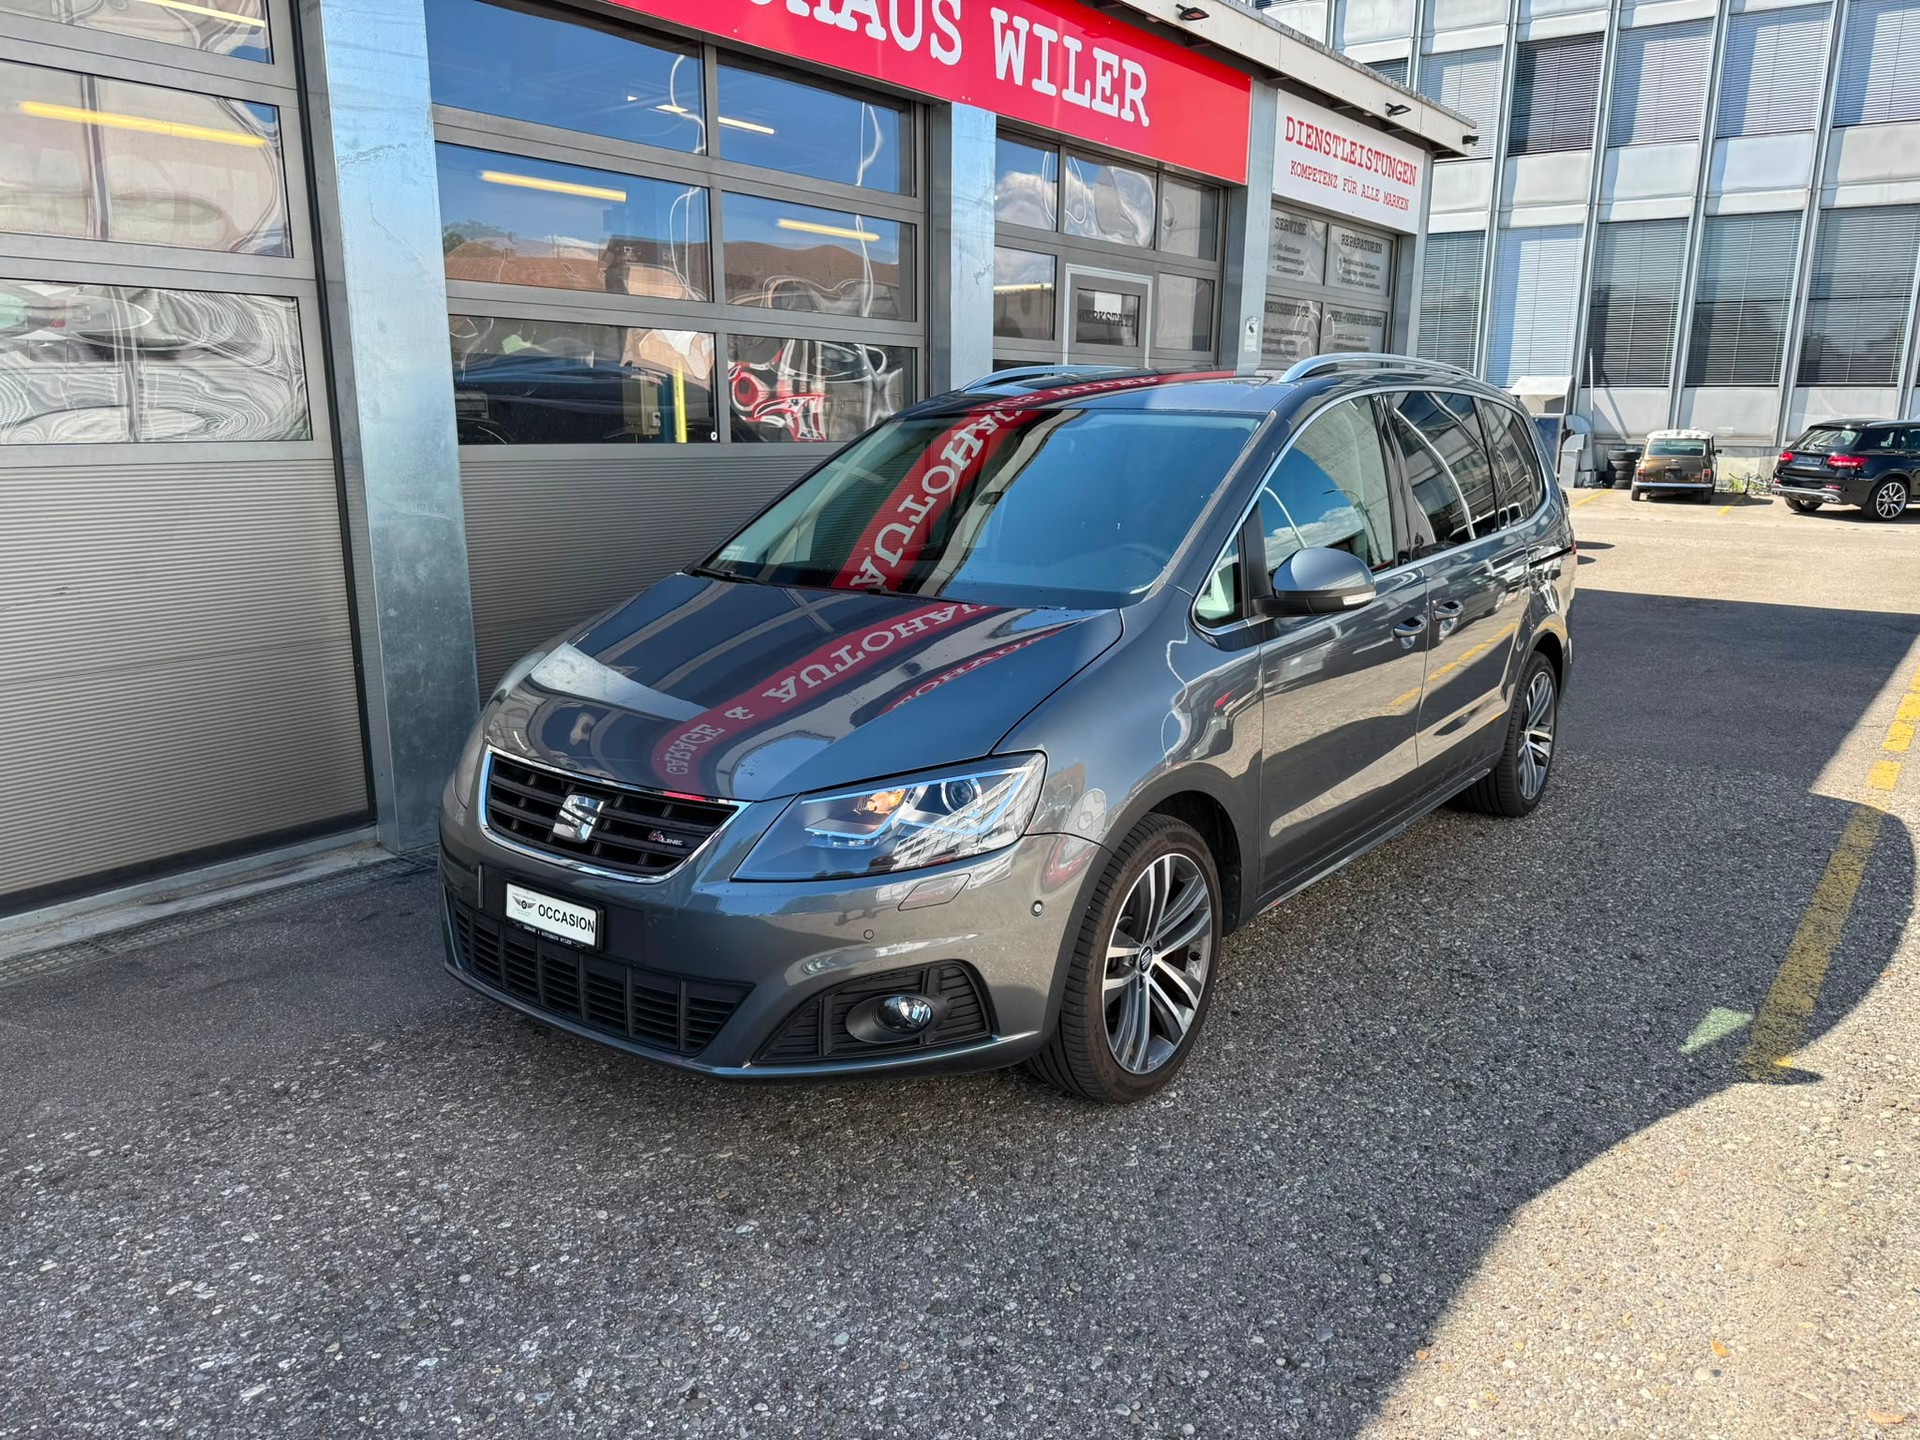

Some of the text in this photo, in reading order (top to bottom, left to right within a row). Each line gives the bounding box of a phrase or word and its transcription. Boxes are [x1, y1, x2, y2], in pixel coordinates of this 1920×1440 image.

[991, 7, 1150, 127] WILER
[1285, 116, 1418, 187] DIENSTLEISTUNGEN
[1290, 160, 1409, 211] KOMPETENZ FÜR ALLE MARKEN
[1274, 217, 1307, 236] SERVICE
[1341, 233, 1383, 254] REPARATUREN
[537, 904, 595, 934] OCCASION
